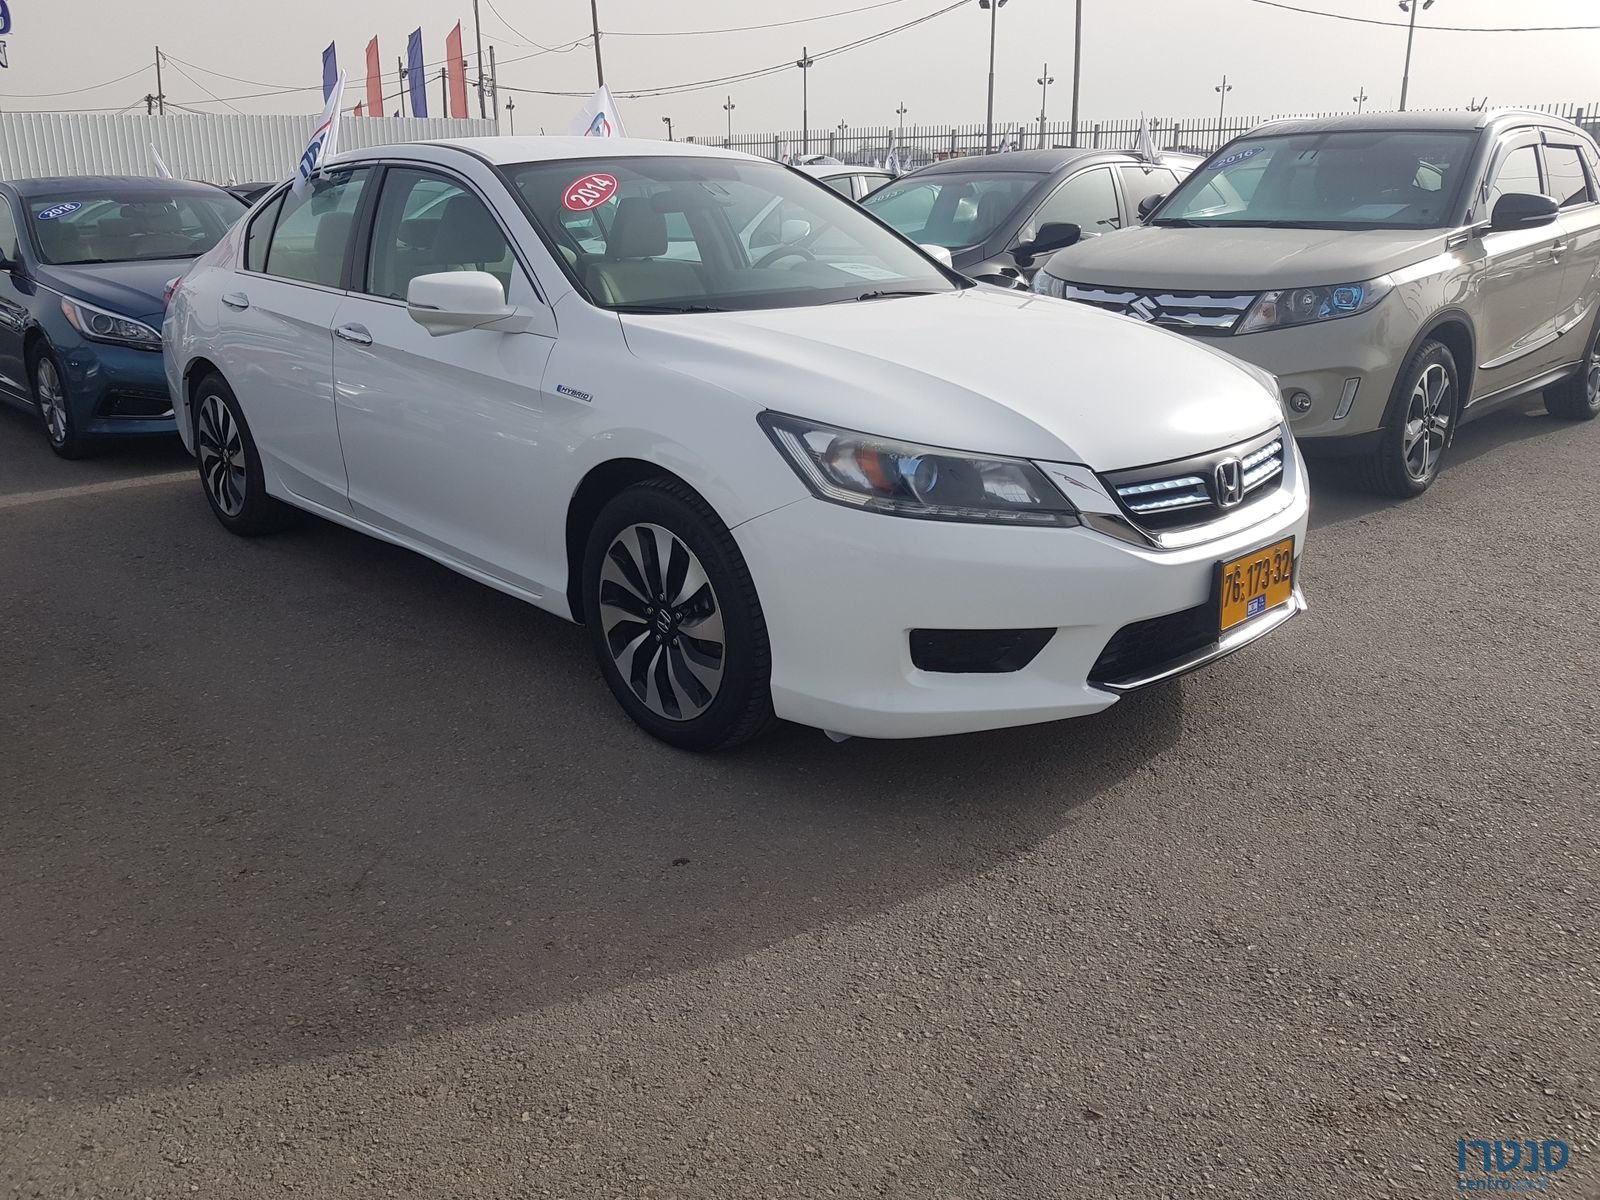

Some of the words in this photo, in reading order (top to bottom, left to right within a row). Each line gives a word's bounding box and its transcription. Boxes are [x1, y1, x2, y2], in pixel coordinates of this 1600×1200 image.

[1219, 150, 1254, 166] 2016
[570, 177, 613, 206] 2014
[44, 203, 76, 217] 2016
[561, 387, 589, 399] HYBRID
